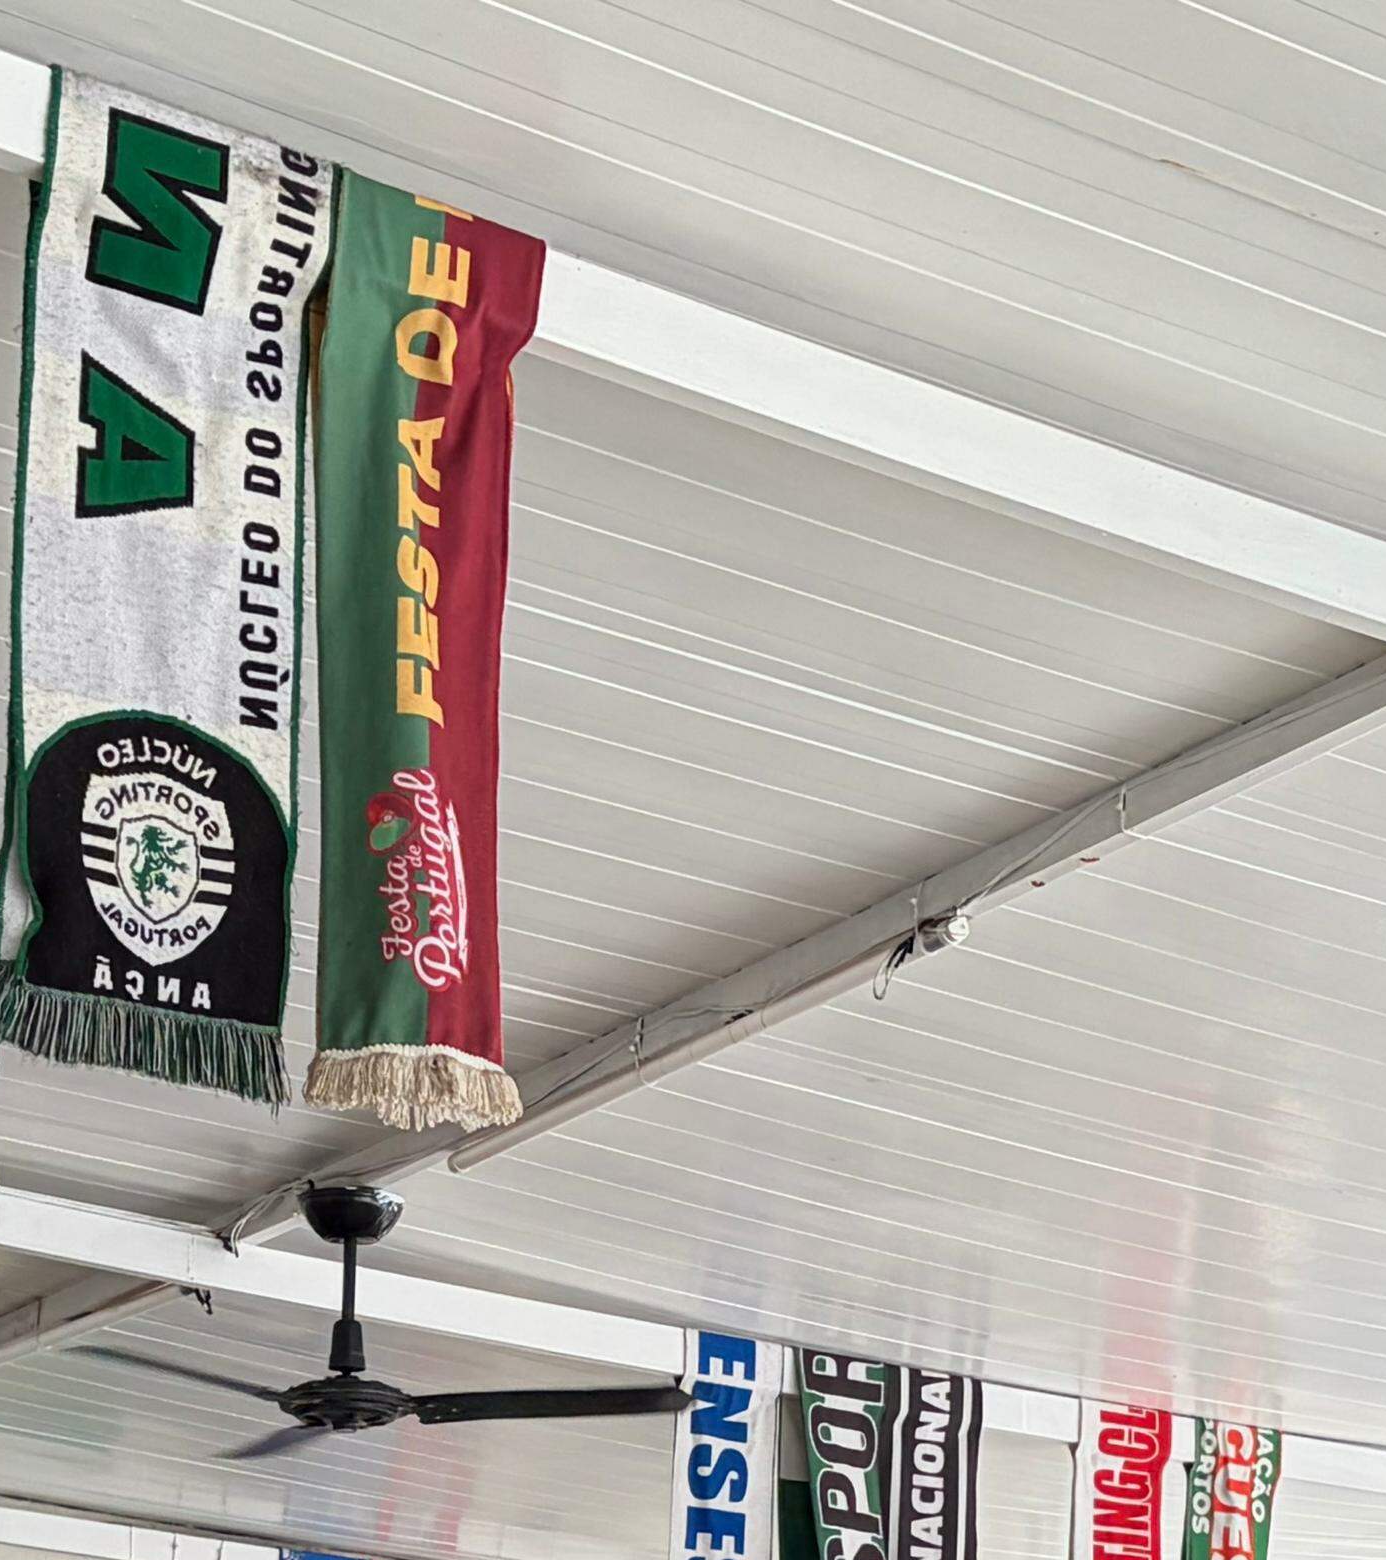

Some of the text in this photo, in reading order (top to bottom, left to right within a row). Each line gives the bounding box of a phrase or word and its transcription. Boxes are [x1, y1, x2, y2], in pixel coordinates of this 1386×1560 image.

[394, 236, 471, 386] DE
[396, 416, 444, 728] FESTA
[381, 843, 422, 963] Festa de
[393, 767, 462, 988] Portugal
